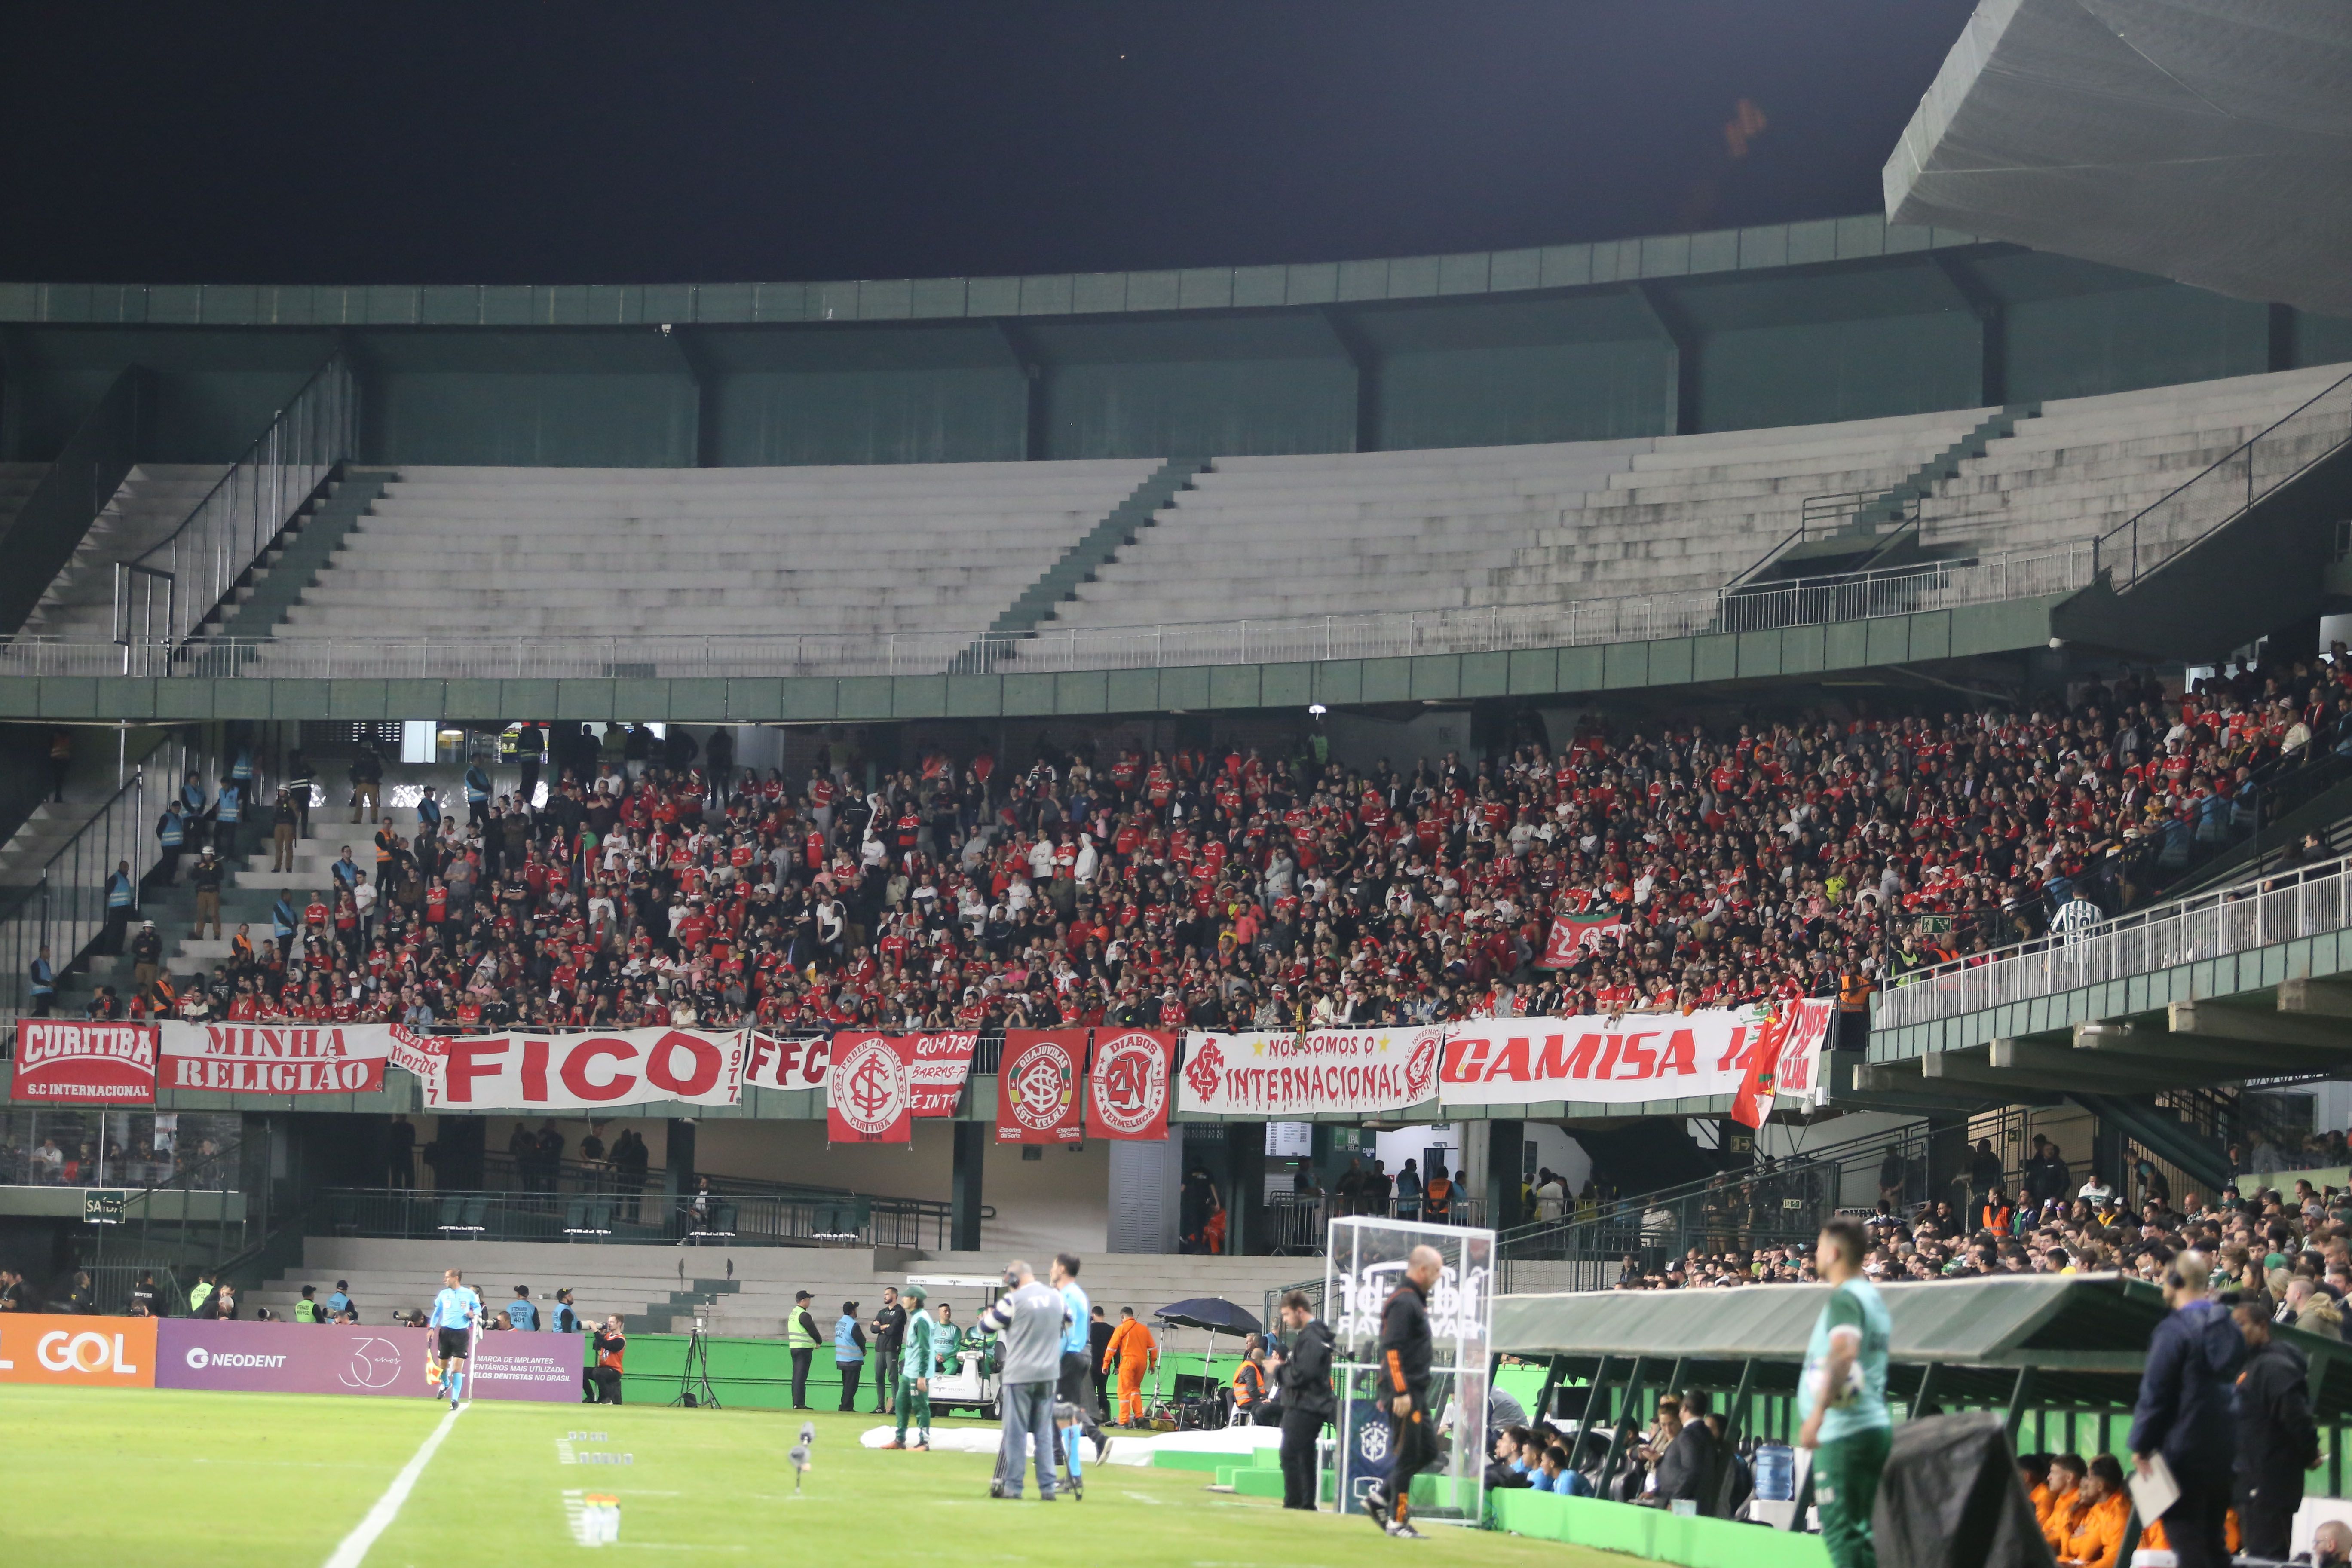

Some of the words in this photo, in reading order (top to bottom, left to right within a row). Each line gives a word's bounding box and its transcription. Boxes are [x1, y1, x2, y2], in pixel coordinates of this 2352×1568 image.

[24, 1024, 153, 1065] CURITIBA
[205, 1026, 348, 1058] MINHA
[1109, 1036, 1158, 1055] DIABOS
[1269, 1035, 1298, 1058] NÓS
[1304, 1036, 1358, 1057] SOMOS
[1364, 1036, 1374, 1057] O
[446, 1030, 722, 1102] FICO
[746, 1036, 829, 1086] FFC
[841, 1042, 868, 1070] PODER
[1019, 1045, 1069, 1069] GUAJUVIRAS
[1439, 1029, 1698, 1083] CAMISA
[175, 1056, 369, 1091] RELIGIÃO
[1108, 1056, 1153, 1110] ZN
[1226, 1063, 1402, 1106] INTERNACIONAL
[28, 1084, 46, 1094] S.C
[49, 1083, 149, 1097] INTERNACIONAL
[850, 1118, 891, 1132] CURITIBA
[1015, 1104, 1032, 1126] EST.
[1035, 1103, 1067, 1127] VELHA
[1102, 1105, 1155, 1128] VERMELHOS
[1348, 1135, 1358, 1143] IPA
[86, 1197, 123, 1214] SAÍDA
[1028, 1295, 1050, 1308] TV
[37, 1331, 137, 1373] GOL
[212, 1354, 287, 1368] NEODENT
